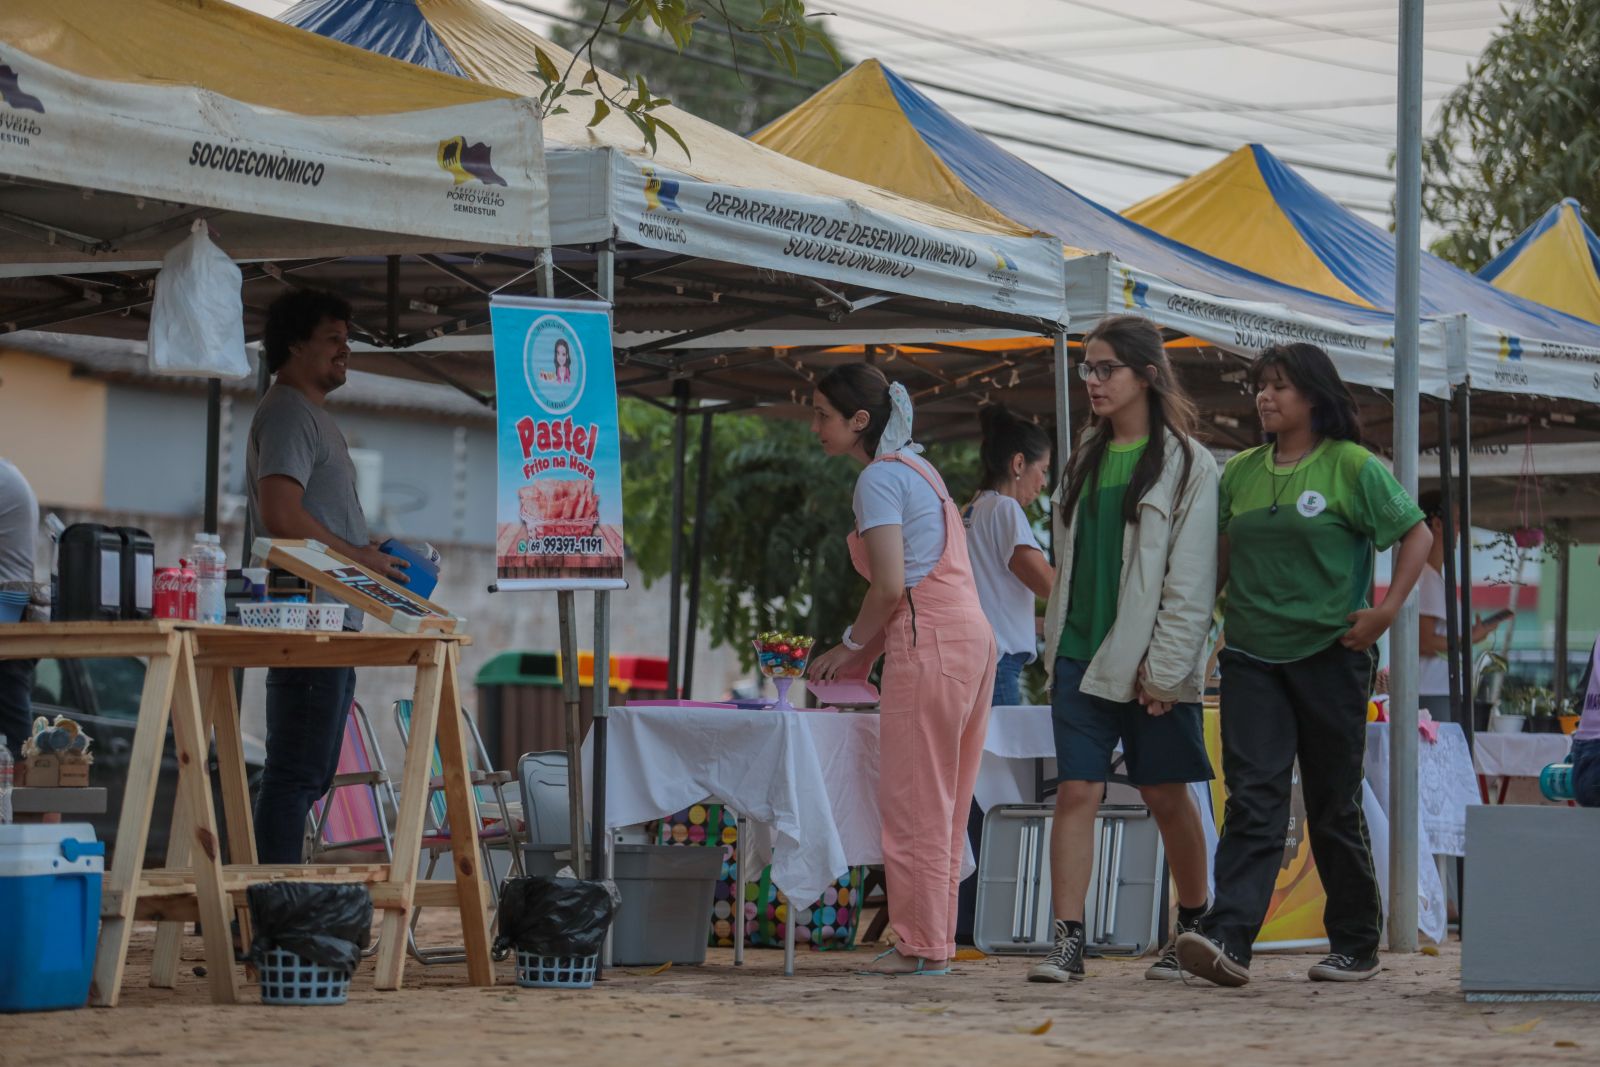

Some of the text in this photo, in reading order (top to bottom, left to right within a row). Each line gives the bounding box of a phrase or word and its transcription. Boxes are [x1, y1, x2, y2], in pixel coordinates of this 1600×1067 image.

[446, 191, 505, 207] PORTO VELHO
[453, 203, 497, 217] SEMDESTUR
[639, 222, 687, 244] PORTO VELHO
[706, 191, 977, 269] DEPARTAMENTO DE DESENVOLVIMENTO
[516, 416, 598, 460] Pastel
[522, 454, 595, 480] Frito na Hora
[528, 537, 603, 553] (69) 99397-1191
